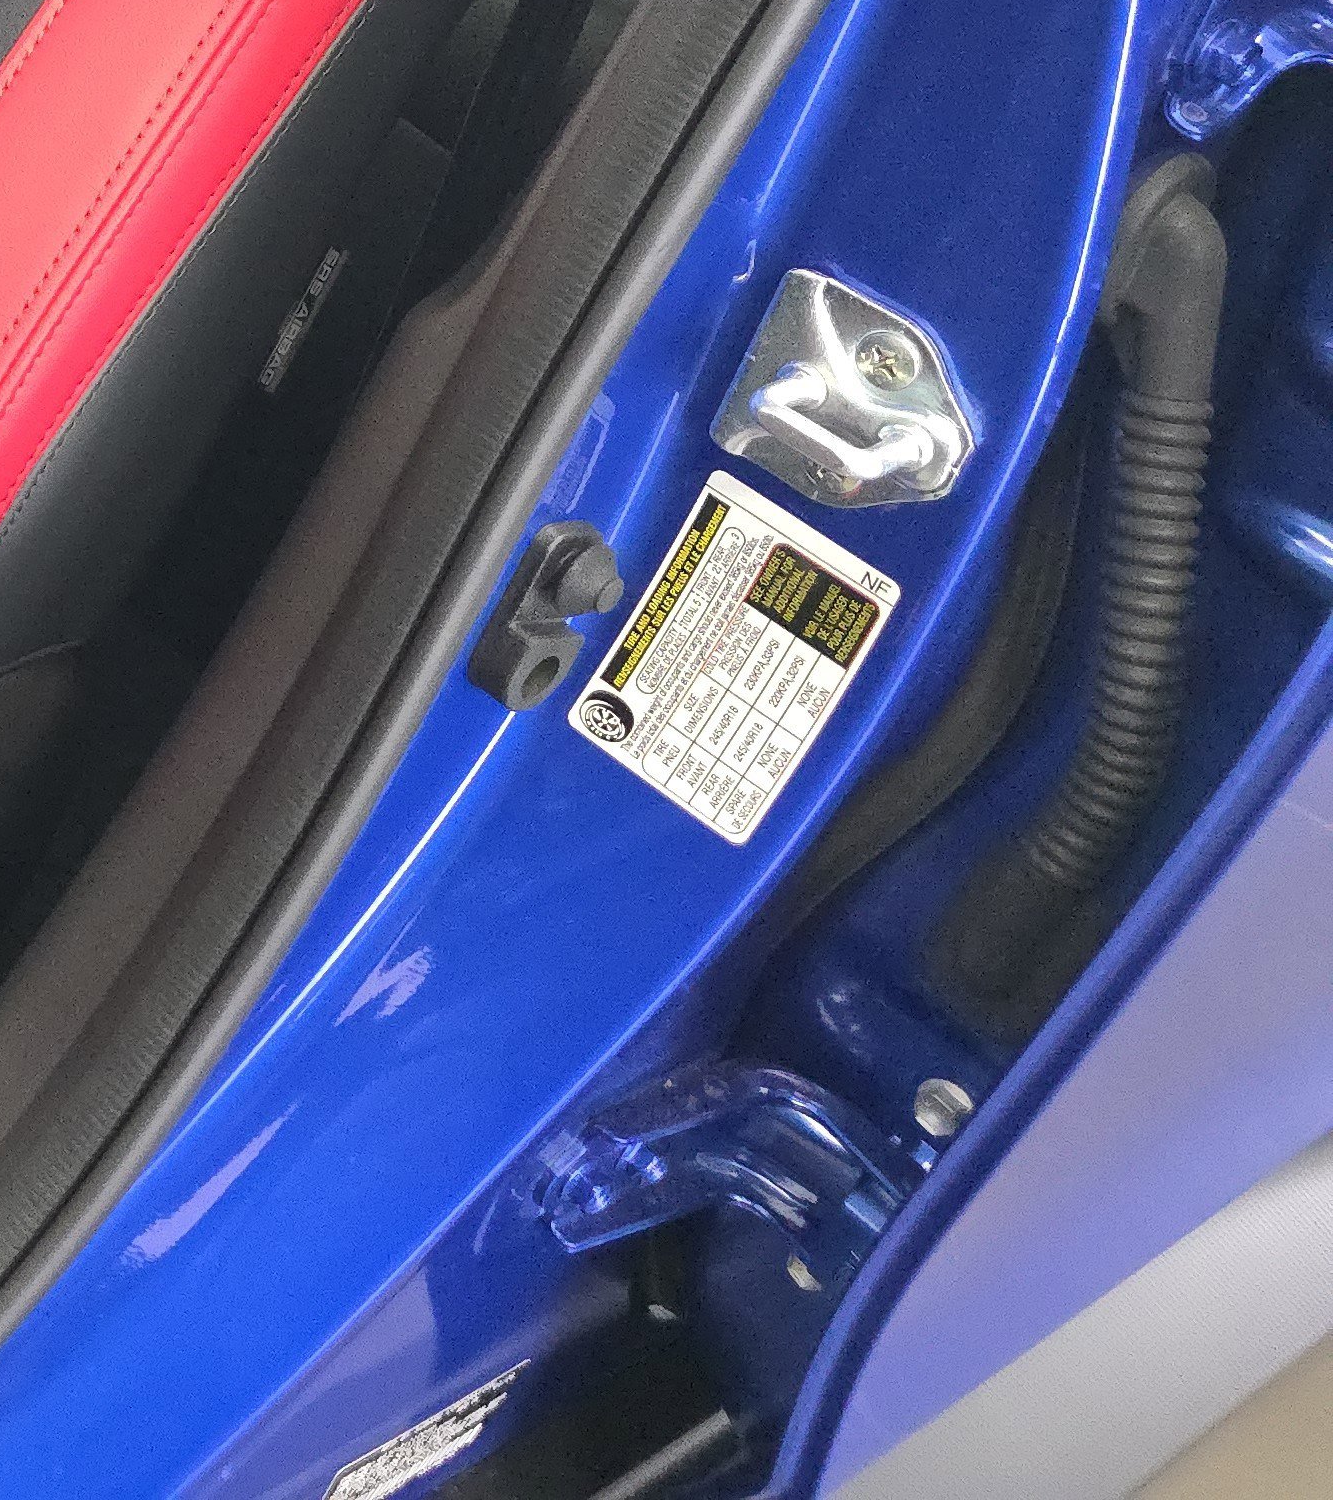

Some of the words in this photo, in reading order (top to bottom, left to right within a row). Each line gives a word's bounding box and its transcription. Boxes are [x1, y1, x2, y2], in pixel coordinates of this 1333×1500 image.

[260, 302, 309, 386] AIRBAG
[731, 532, 740, 540] 3
[711, 545, 726, 563] REAR
[695, 571, 711, 591] FRONT
[711, 565, 721, 574] 2
[749, 584, 765, 603] SEE
[758, 547, 786, 586] OWNER'S
[760, 573, 786, 607] MANUAL
[780, 555, 796, 573] FOR
[613, 625, 656, 687] RENSEIGNEMENTS
[651, 609, 666, 627] SUR
[661, 595, 674, 611] LES
[669, 570, 689, 597] PNEUS
[683, 560, 694, 572] ET
[689, 549, 701, 562] LE
[695, 504, 726, 552] CHARGEMENT
[623, 630, 640, 651] TIRE
[635, 612, 651, 632] AND
[645, 579, 671, 615] LOADING
[664, 527, 701, 581] INFORMATION
[704, 576, 720, 597] AVANT
[772, 565, 805, 613] ADDITIONAL
[782, 568, 818, 622] INFORMATION
[817, 582, 841, 612] MANUEL
[860, 571, 891, 598] NF
[680, 603, 698, 627] TOTAL
[692, 598, 701, 606] 5
[709, 599, 722, 616] never
[812, 609, 825, 622] LE
[822, 594, 849, 630] L'USAGER
[696, 614, 713, 635] should
[801, 619, 819, 639] VOIR
[816, 627, 830, 641] DE
[826, 628, 845, 650] POUR
[838, 609, 855, 630] PLUS
[848, 598, 862, 612] DE
[834, 601, 876, 663] RENSEIGNEMENTS
[687, 633, 704, 653] cargo
[703, 654, 719, 674] COLD
[715, 638, 728, 655] TIRE
[724, 604, 750, 640] PRESSURE
[718, 635, 743, 670] PRESSION
[738, 620, 752, 636] DES
[725, 652, 744, 677] PNEUS
[744, 625, 761, 647] FROID
[639, 655, 660, 683] SEATING
[655, 626, 678, 658] CAPACITY
[647, 663, 667, 689] NOMBRE
[662, 654, 672, 665] DE
[668, 631, 686, 656] PLACES
[680, 648, 691, 662] and
[684, 669, 693, 679] du
[689, 637, 715, 672] chargement
[662, 659, 686, 692] occupants
[647, 694, 664, 716] weight
[658, 688, 667, 697] of
[683, 692, 699, 712] SIZE
[796, 680, 817, 708] NONE
[806, 686, 830, 718] AUCUN
[684, 685, 718, 734] DIMENSIONS
[629, 712, 651, 742] combined
[732, 720, 763, 763] 245/40R18
[620, 738, 633, 752] The
[652, 738, 669, 758] TIRE
[662, 744, 680, 767] PNEU
[757, 741, 778, 769] NONE
[675, 752, 697, 781] FRONT
[686, 760, 707, 788] AVANT
[767, 747, 791, 779] AUCUN
[701, 772, 720, 796] REAR
[708, 773, 735, 810] ARRIÈRE
[725, 788, 746, 815] SPARE
[731, 817, 743, 829] DE
[737, 788, 762, 821] SECOURS
